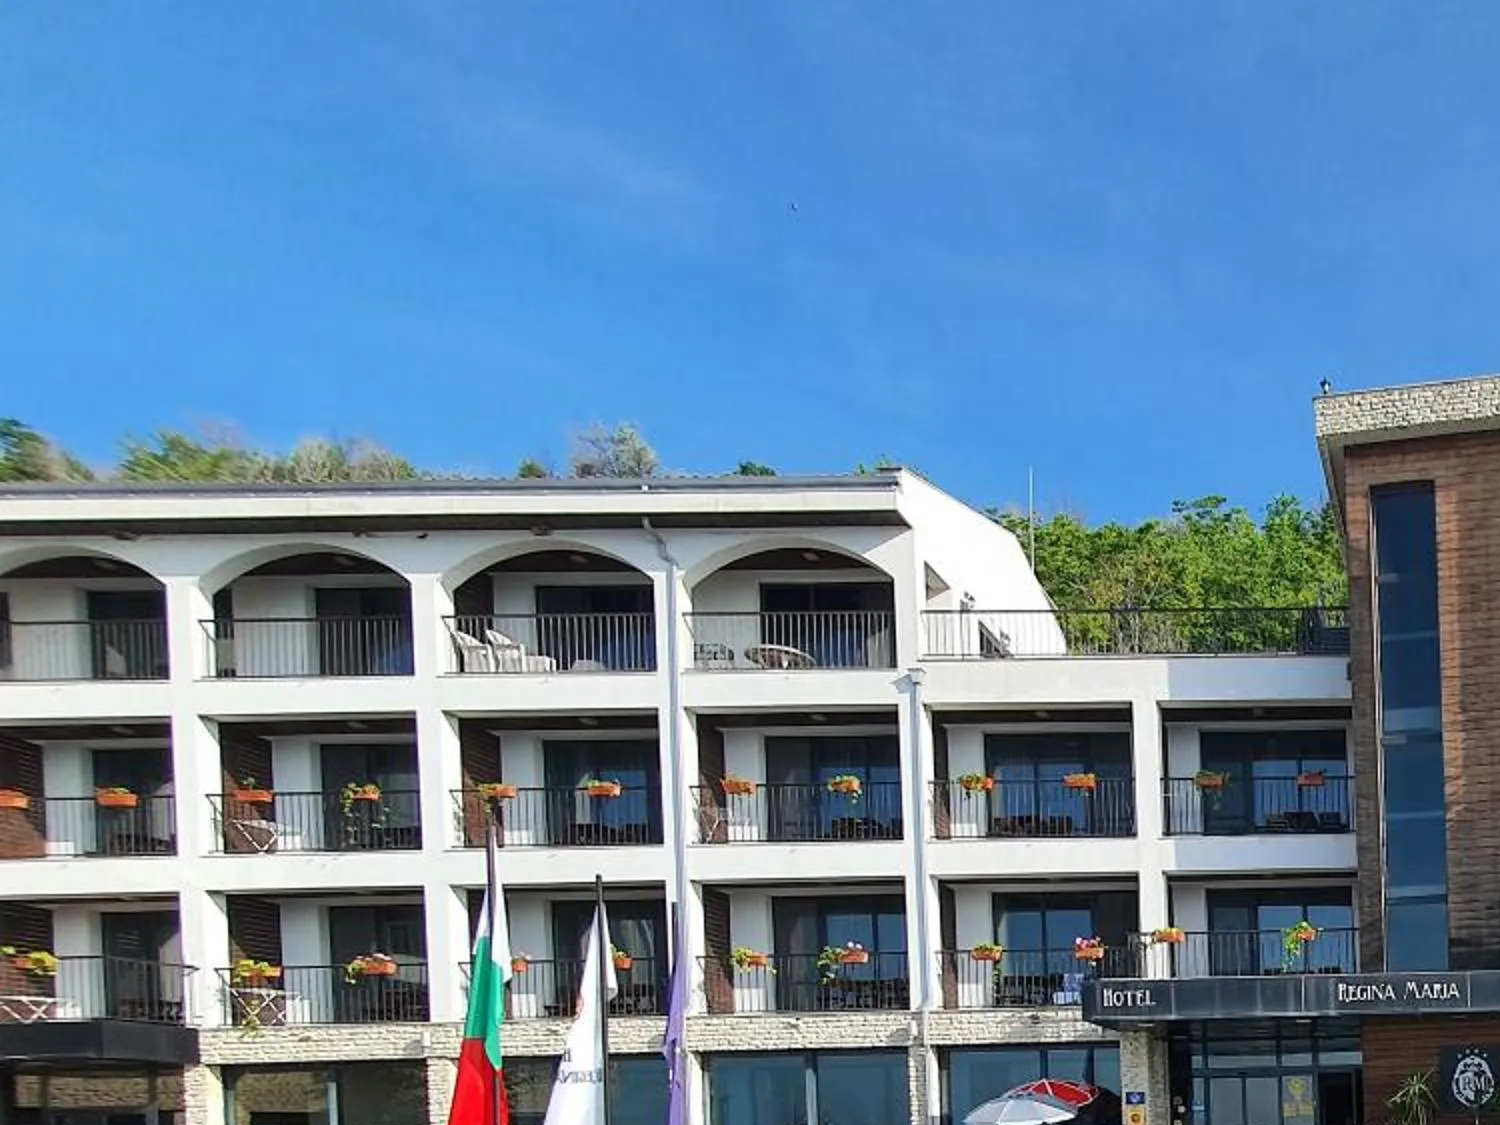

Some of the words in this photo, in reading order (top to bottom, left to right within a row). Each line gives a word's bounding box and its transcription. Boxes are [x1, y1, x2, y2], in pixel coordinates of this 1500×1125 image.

[1103, 988, 1156, 1007] HOTEL
[1337, 983, 1396, 1002] REGINA
[1403, 981, 1460, 1000] MARIA
